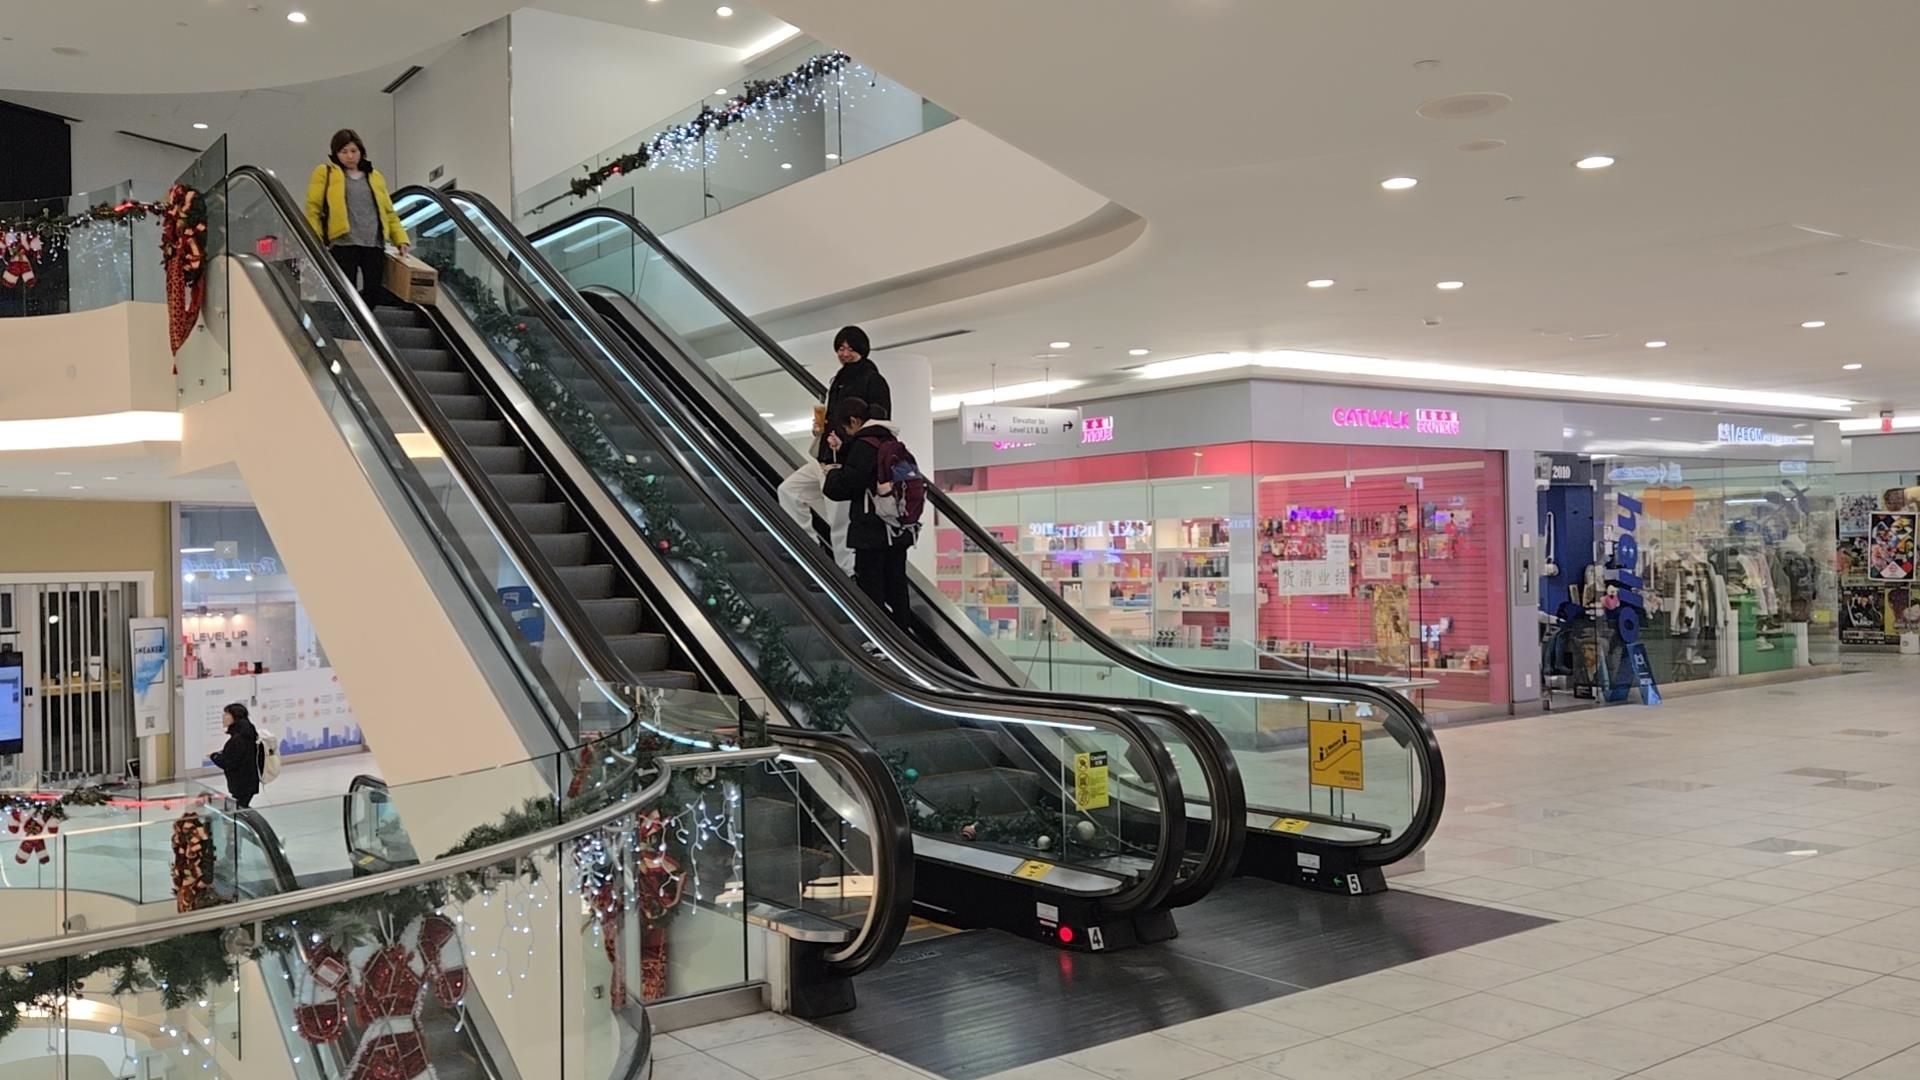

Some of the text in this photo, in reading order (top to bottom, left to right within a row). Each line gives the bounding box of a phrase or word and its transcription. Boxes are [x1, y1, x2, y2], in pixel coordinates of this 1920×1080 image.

[1012, 416, 1036, 424] Elevator
[1332, 407, 1410, 429] CATWALK
[1552, 465, 1570, 479] 2010
[192, 630, 248, 642] LEVEL UP
[1349, 875, 1359, 892] 5
[1092, 928, 1102, 947] 4
